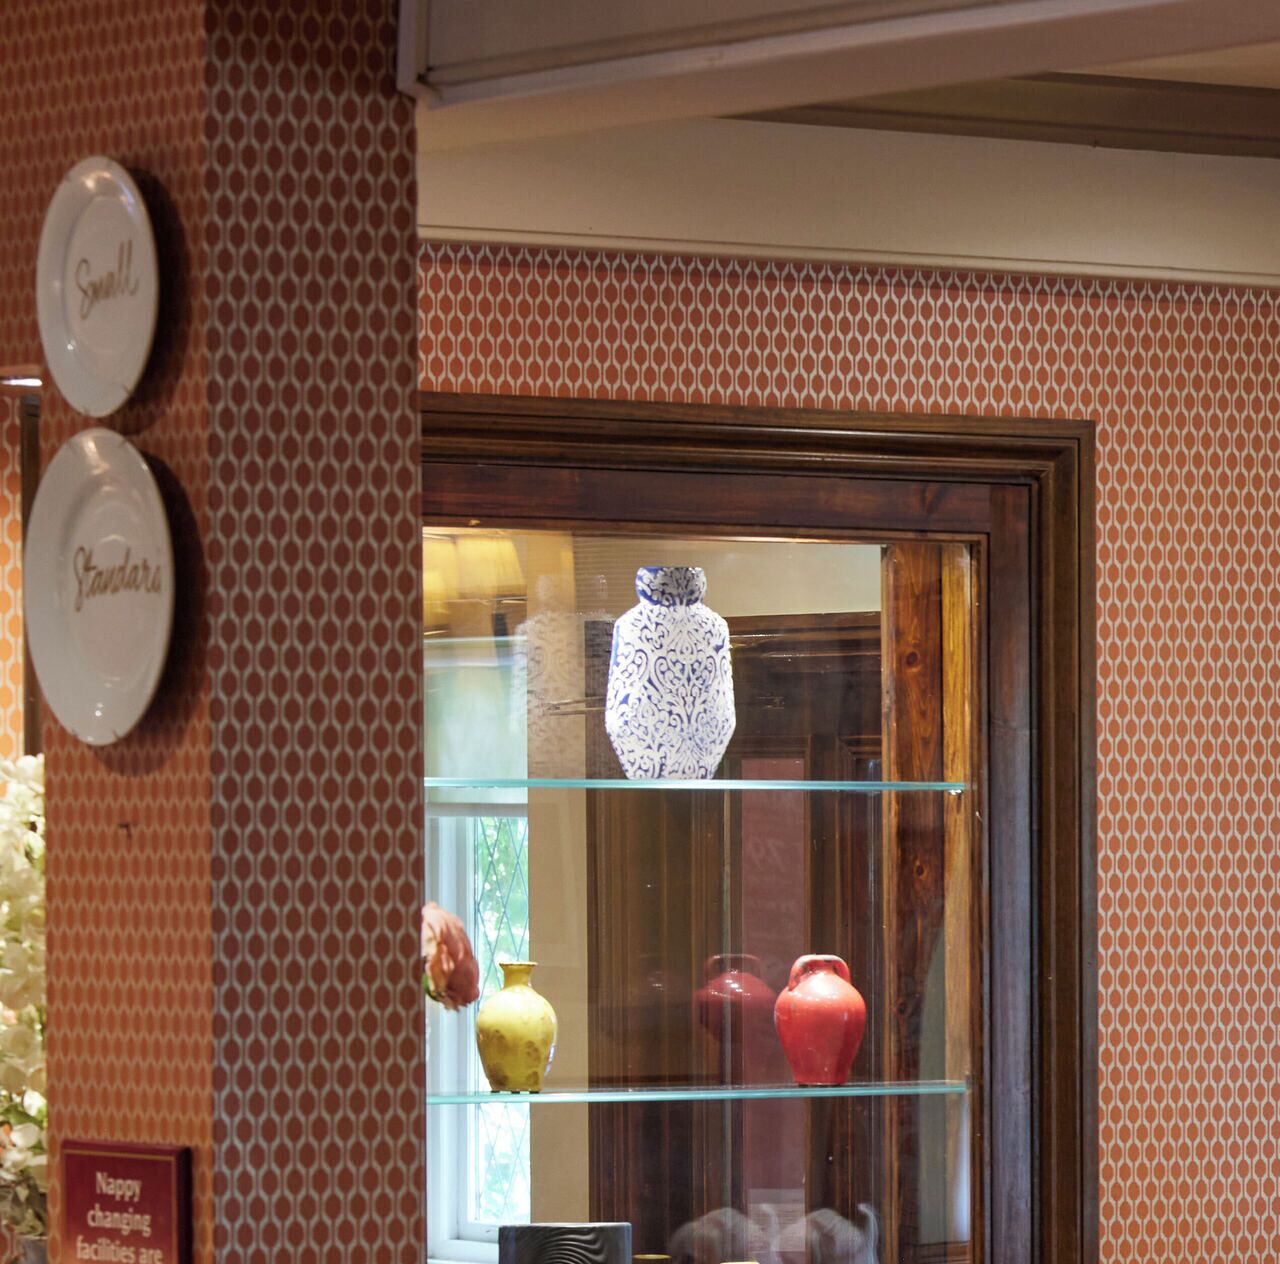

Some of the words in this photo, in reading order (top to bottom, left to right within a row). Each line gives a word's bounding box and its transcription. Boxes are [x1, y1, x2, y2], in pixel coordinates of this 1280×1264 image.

[75, 239, 139, 319] Small
[96, 1172, 142, 1201] Nappy
[87, 1204, 151, 1237] changing
[76, 1235, 136, 1264] facilities
